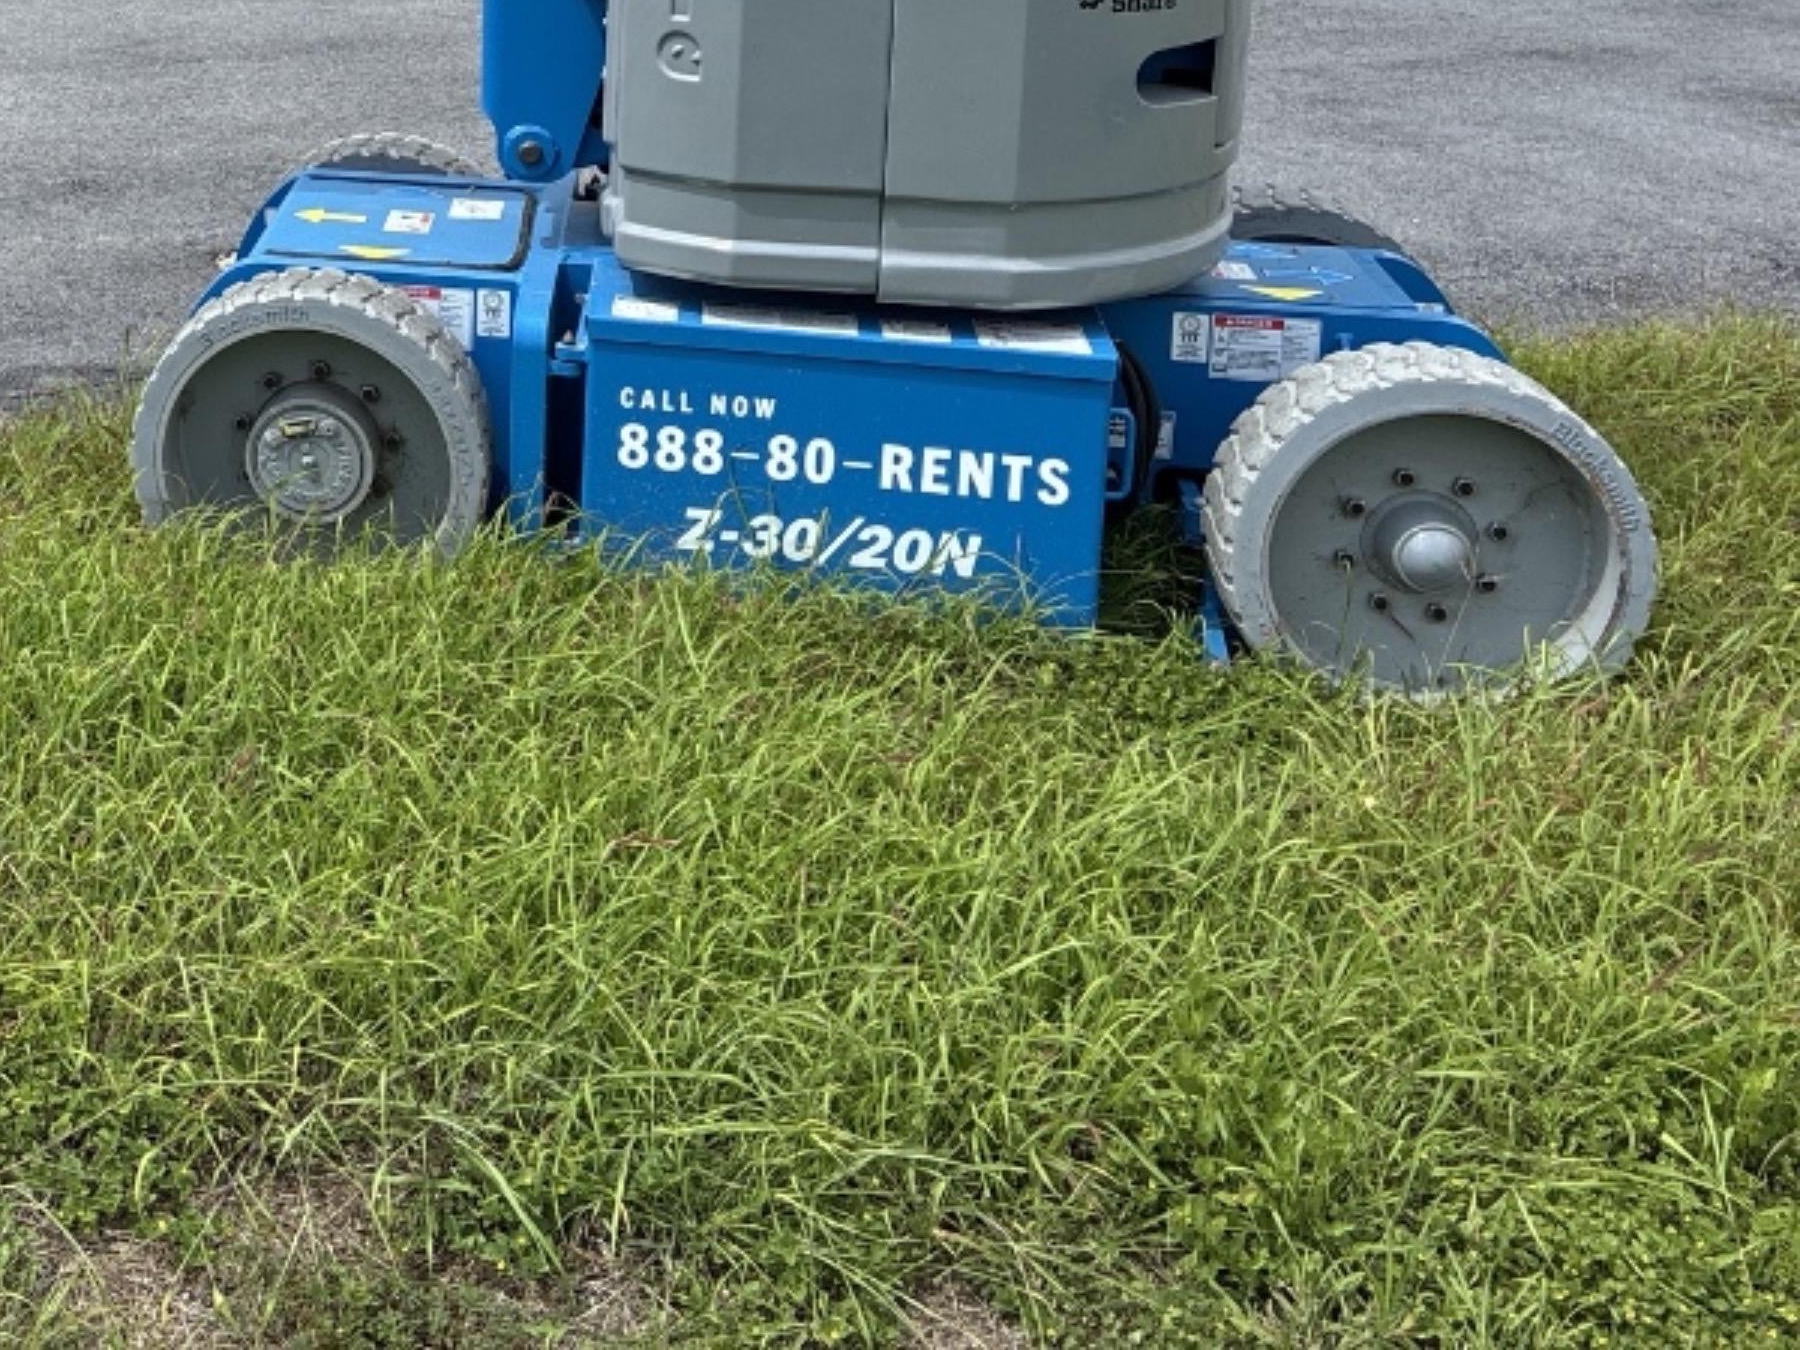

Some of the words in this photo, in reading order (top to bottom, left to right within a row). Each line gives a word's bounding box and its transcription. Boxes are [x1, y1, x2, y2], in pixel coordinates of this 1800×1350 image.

[619, 386, 694, 412] CALL
[709, 393, 778, 419] NOW
[617, 422, 1071, 507] 888-80-RENTS
[675, 506, 983, 578] Z-30/20N
